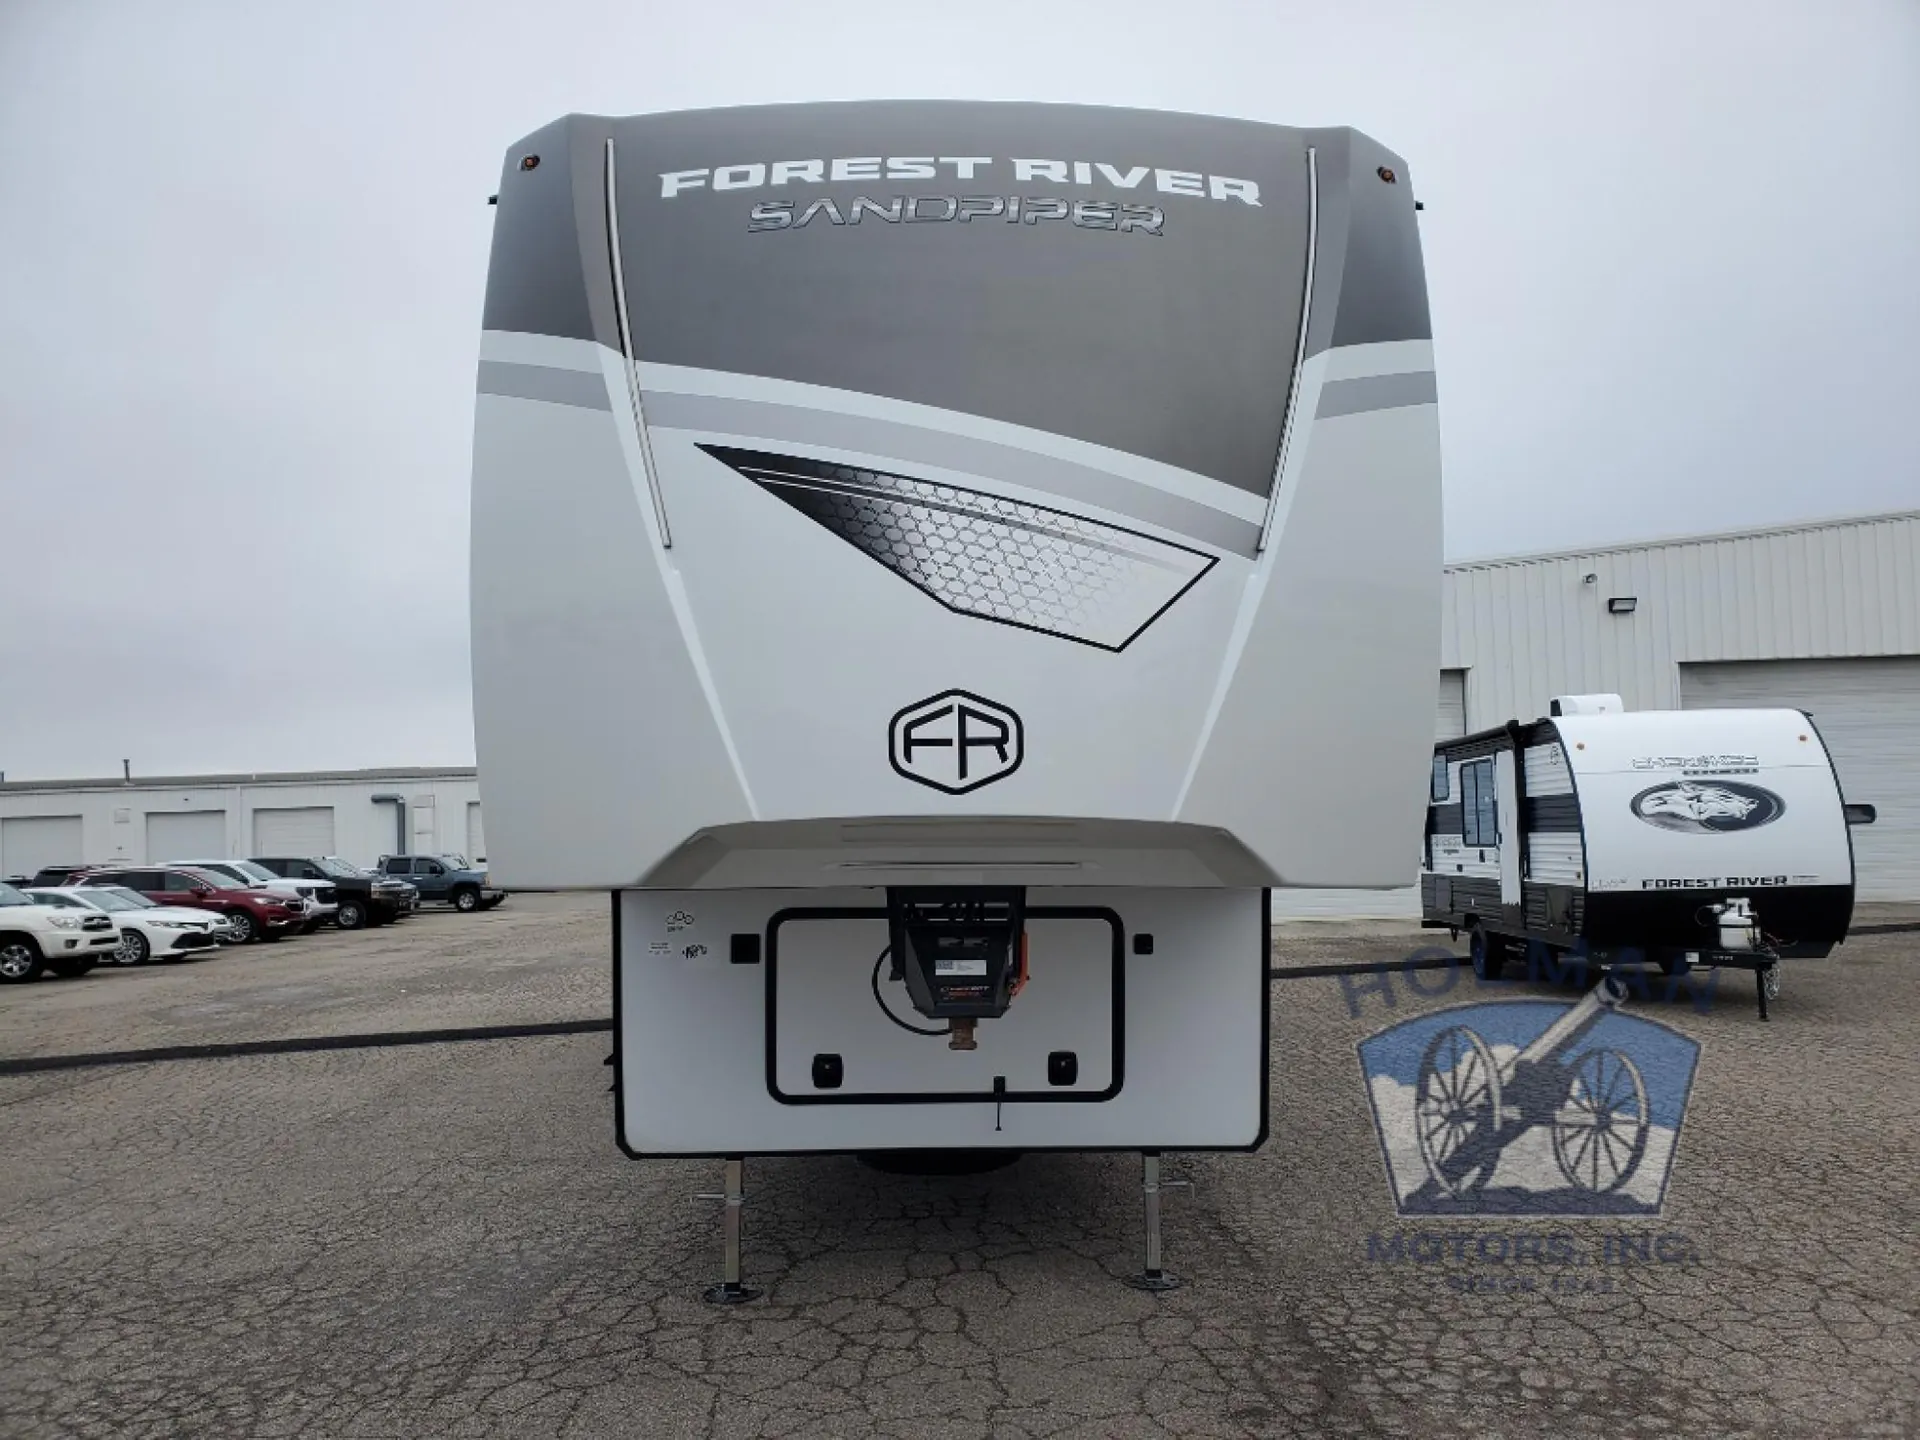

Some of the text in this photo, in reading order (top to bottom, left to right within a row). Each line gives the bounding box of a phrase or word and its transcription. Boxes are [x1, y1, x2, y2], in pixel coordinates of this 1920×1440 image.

[658, 156, 1263, 207] FOREST RIVER
[747, 195, 1165, 236] SANDPIPER
[903, 703, 1010, 781] FR
[1642, 879, 1721, 890] FOREST
[1727, 876, 1788, 888] RIVER
